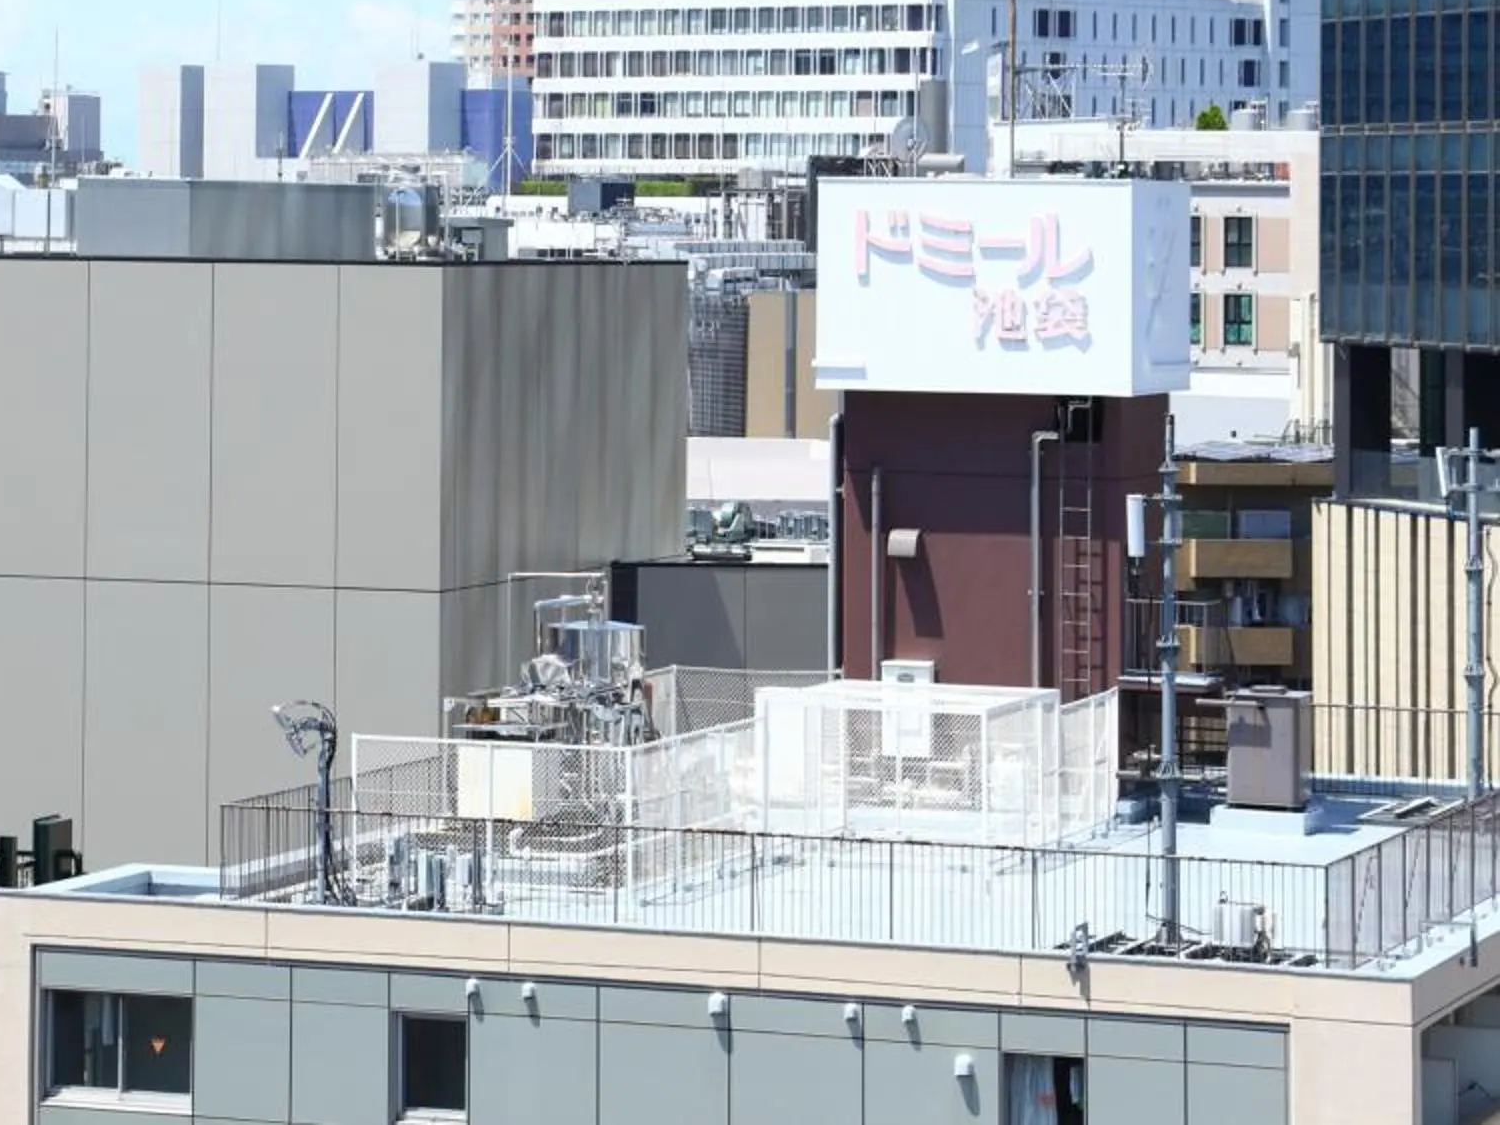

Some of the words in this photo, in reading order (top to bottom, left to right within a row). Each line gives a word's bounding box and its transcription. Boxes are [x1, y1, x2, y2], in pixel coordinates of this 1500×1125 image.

[856, 208, 1094, 283] ドミール
[973, 287, 1091, 349] 池袋
